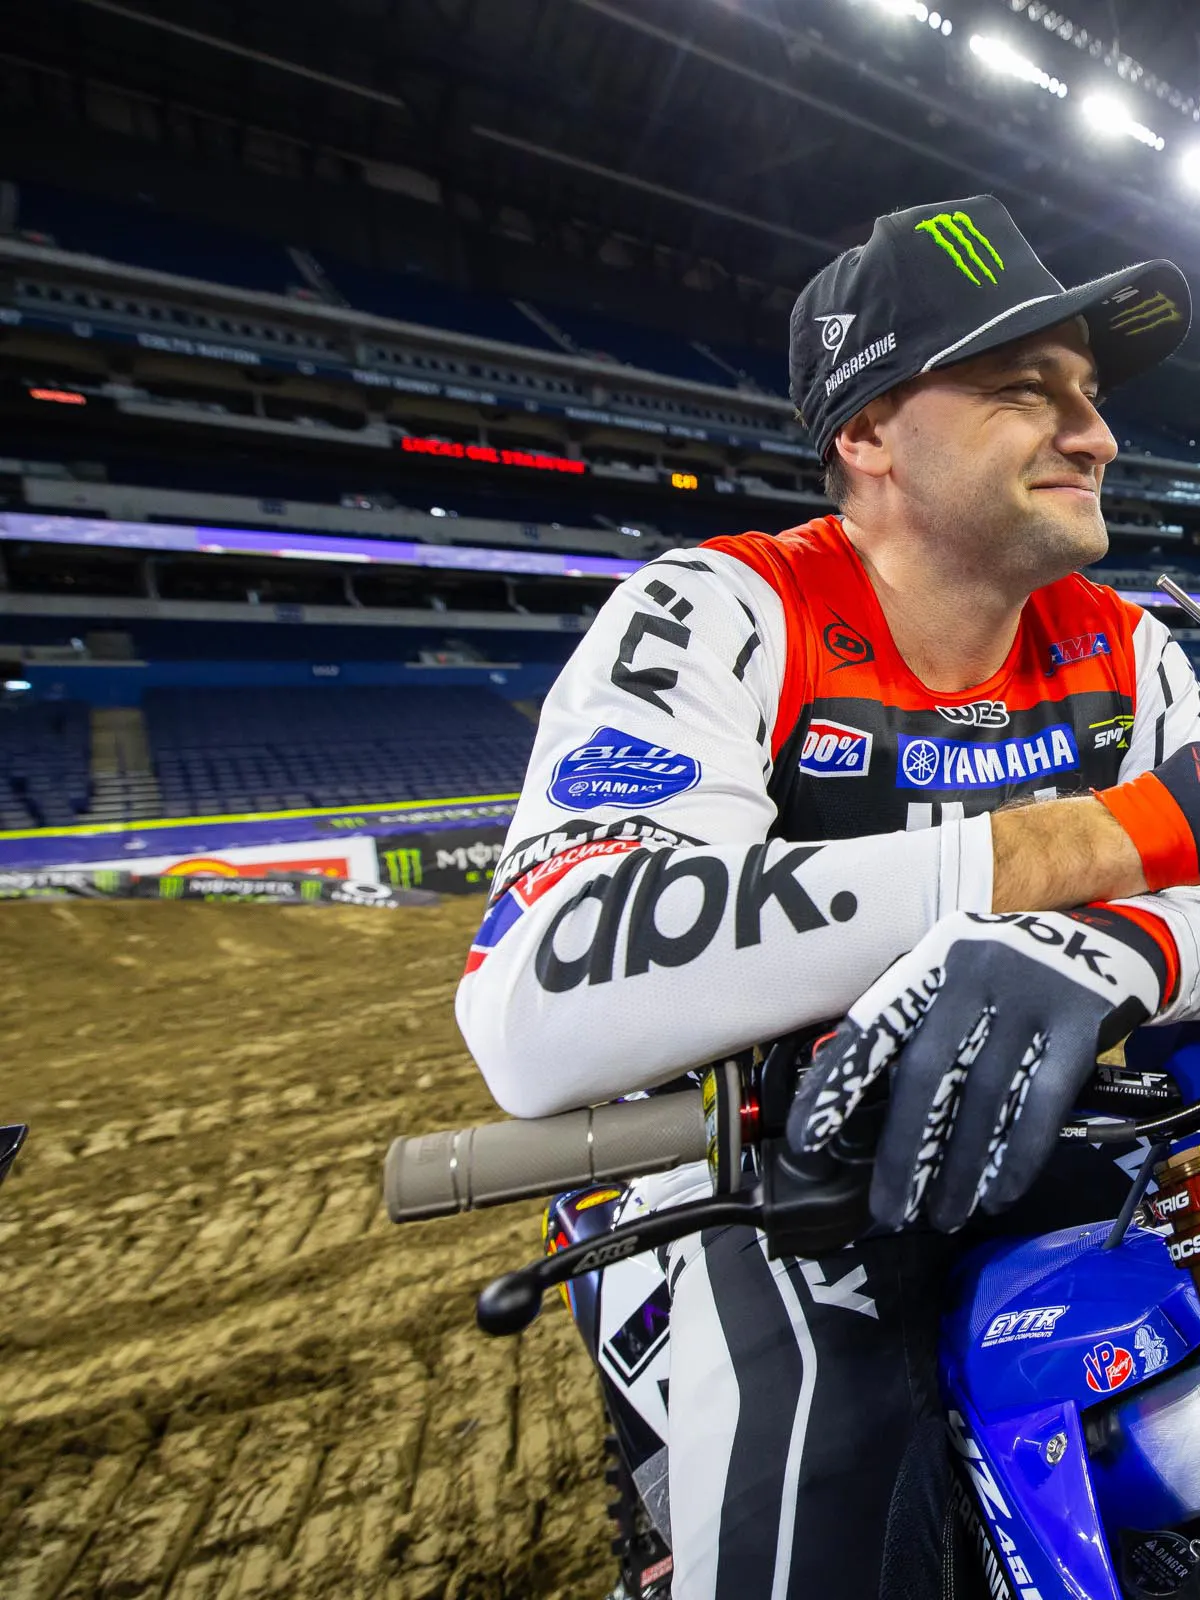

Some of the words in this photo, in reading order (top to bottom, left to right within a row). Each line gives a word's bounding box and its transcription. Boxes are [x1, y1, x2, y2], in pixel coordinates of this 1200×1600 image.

[825, 332, 896, 397] PROGRESSIVE
[402, 436, 464, 459] LUCAS
[466, 445, 500, 463] OIL
[500, 450, 586, 475] STADIUM
[568, 745, 676, 761] BLU
[573, 760, 688, 775] CRU
[800, 731, 865, 768] 00%
[943, 728, 1075, 785] YAMAHA
[984, 1305, 1068, 1341] GYTR
[1156, 1545, 1190, 1579] DANGER
